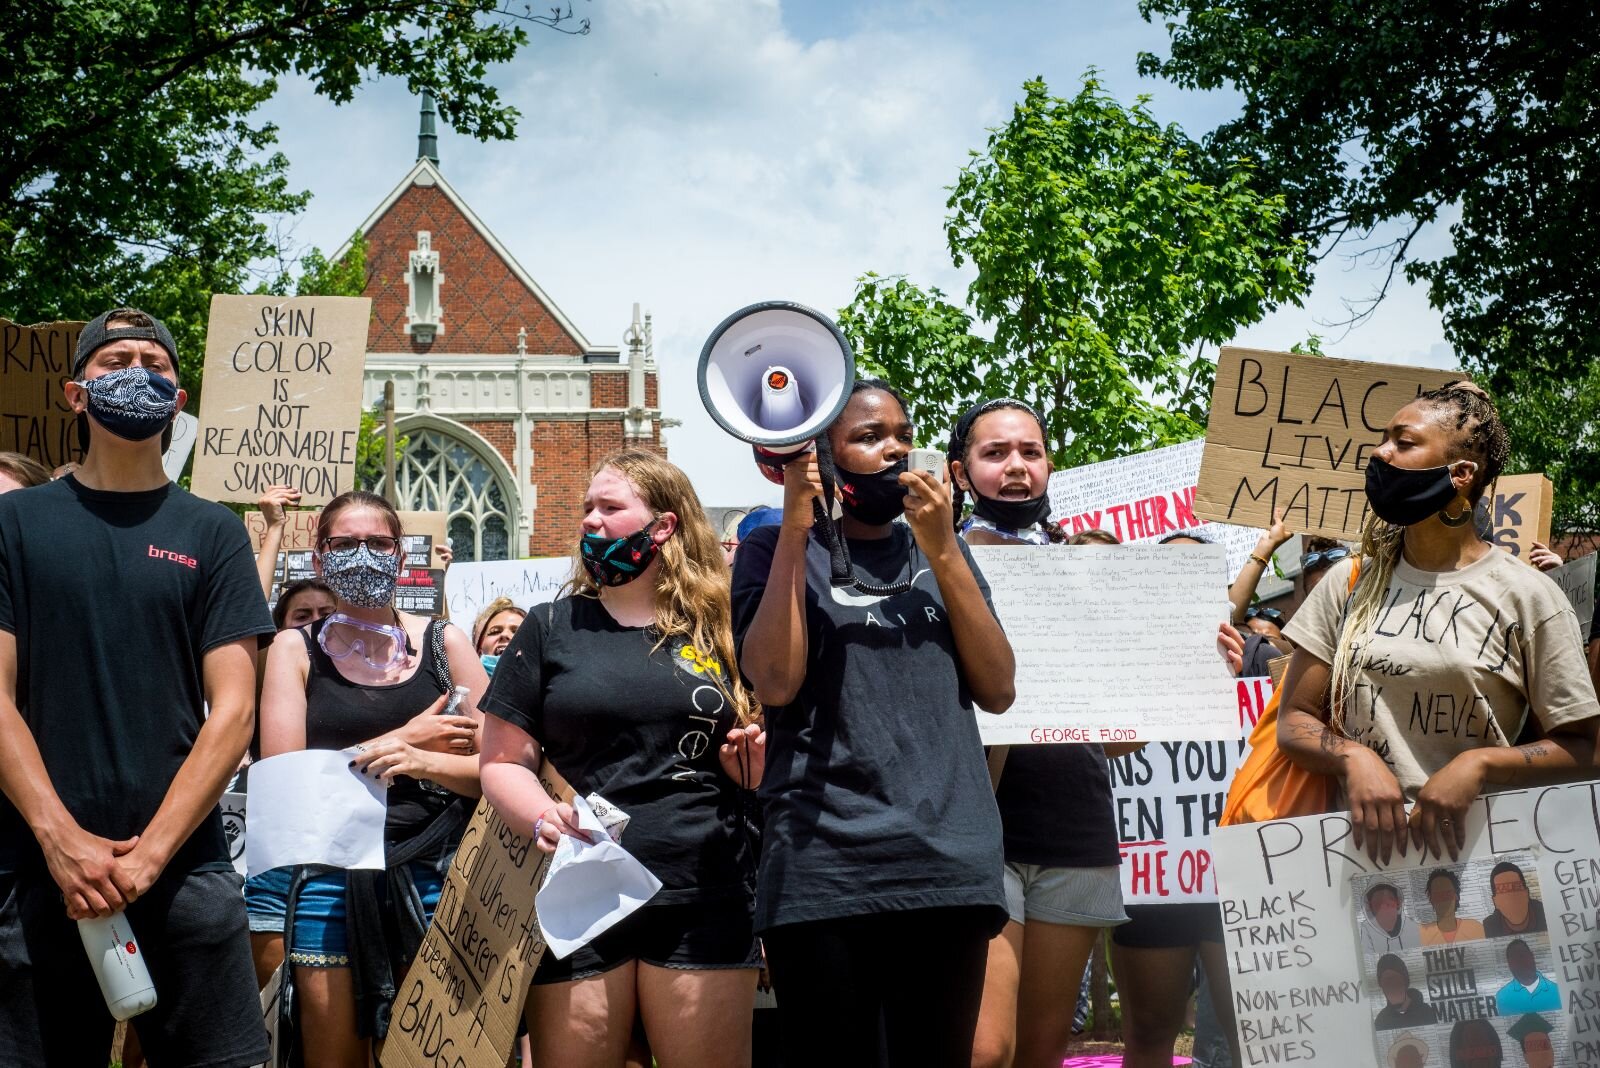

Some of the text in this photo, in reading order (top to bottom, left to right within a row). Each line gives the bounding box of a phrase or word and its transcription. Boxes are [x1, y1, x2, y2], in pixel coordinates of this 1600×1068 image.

[254, 306, 315, 338] SKIN
[4, 325, 80, 374] RACI
[232, 341, 332, 375] COLOR
[273, 378, 288, 402] IS
[1234, 358, 1400, 433] BLAC
[258, 404, 309, 430] NOT
[203, 427, 355, 465] REASONABLE
[1261, 427, 1377, 471] LIVE
[224, 461, 338, 497] SUSPICION
[1106, 495, 1177, 544] THEIR
[148, 544, 197, 569] brose
[865, 606, 941, 626] AIR
[1409, 691, 1500, 740] NEVER
[1030, 728, 1137, 743] GEORGE FLOYD
[1161, 741, 1227, 784] YOU
[1117, 792, 1229, 842] EN TH
[1257, 782, 1600, 888] PRECT
[1178, 849, 1218, 895] OP
[1222, 889, 1316, 925] BLACK
[1227, 916, 1317, 948] TRANS
[1234, 945, 1313, 974] LIVES
[1422, 947, 1466, 972] THEY
[1563, 963, 1600, 983] LIV
[1236, 980, 1362, 1015] NON-BINARY
[1428, 970, 1477, 999] STILL
[398, 979, 467, 1068] BADG
[1430, 995, 1499, 1023] MATTER
[1240, 1013, 1315, 1042] BLACK
[1245, 1040, 1317, 1066] LIVES
